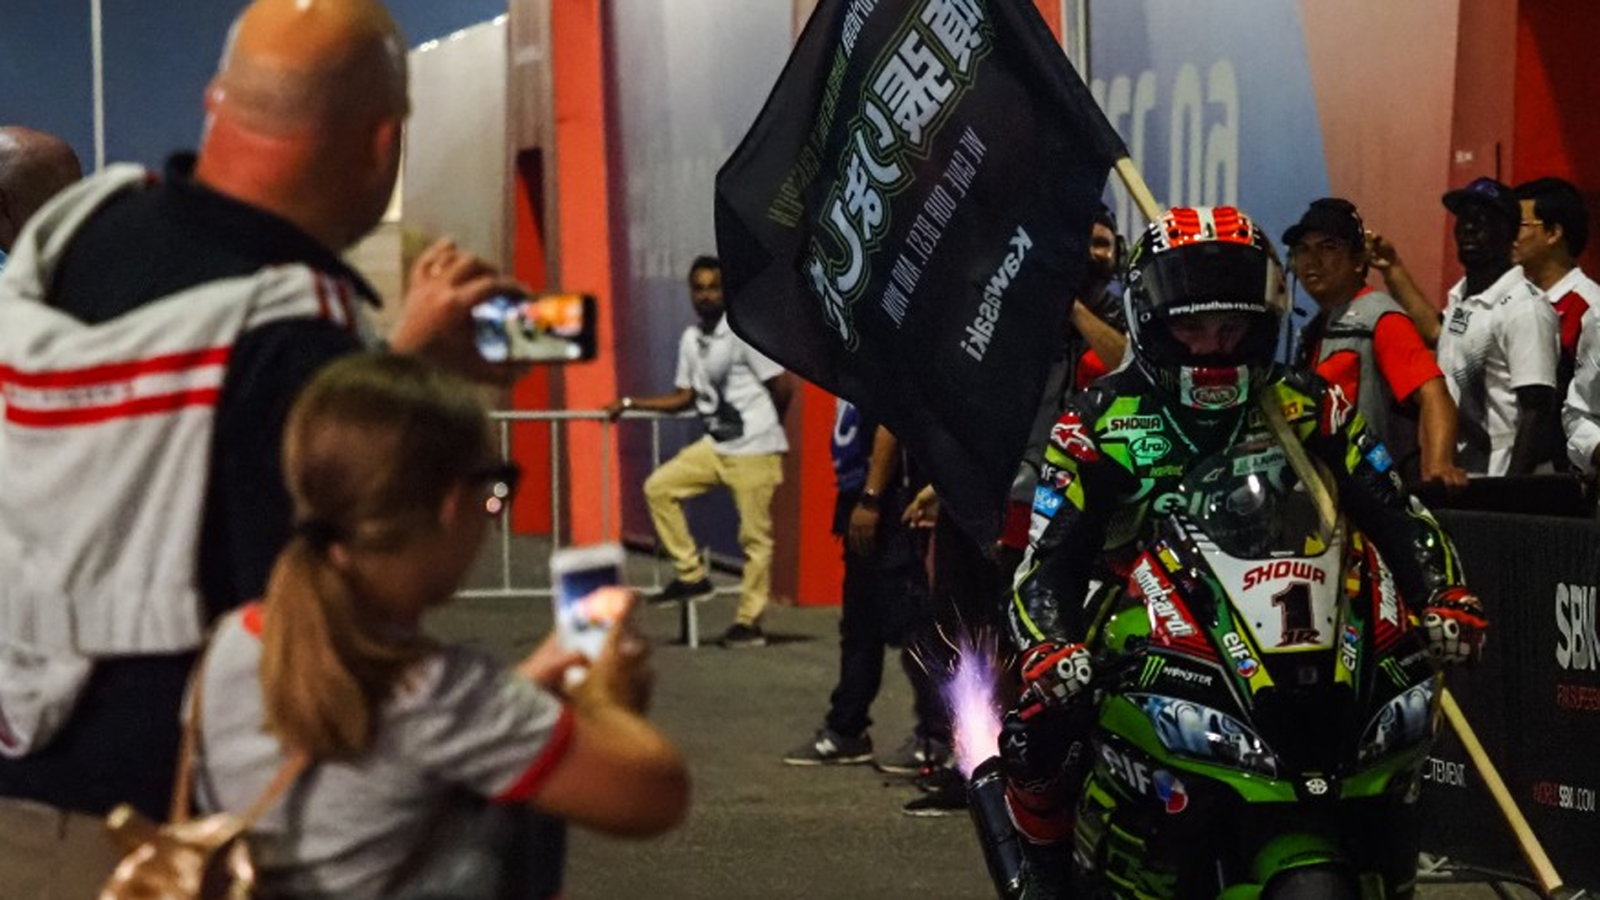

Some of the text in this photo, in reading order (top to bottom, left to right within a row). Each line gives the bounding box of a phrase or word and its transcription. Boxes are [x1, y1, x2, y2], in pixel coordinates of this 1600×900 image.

[1110, 417, 1161, 432] SHOWA
[1243, 561, 1326, 592] SHOWA
[1271, 581, 1315, 634] 1
[1554, 582, 1600, 671] SBK
[1221, 631, 1250, 660] elf
[1341, 643, 1357, 671] elf
[1162, 666, 1213, 686] MONSTER
[1102, 744, 1151, 795] elf
